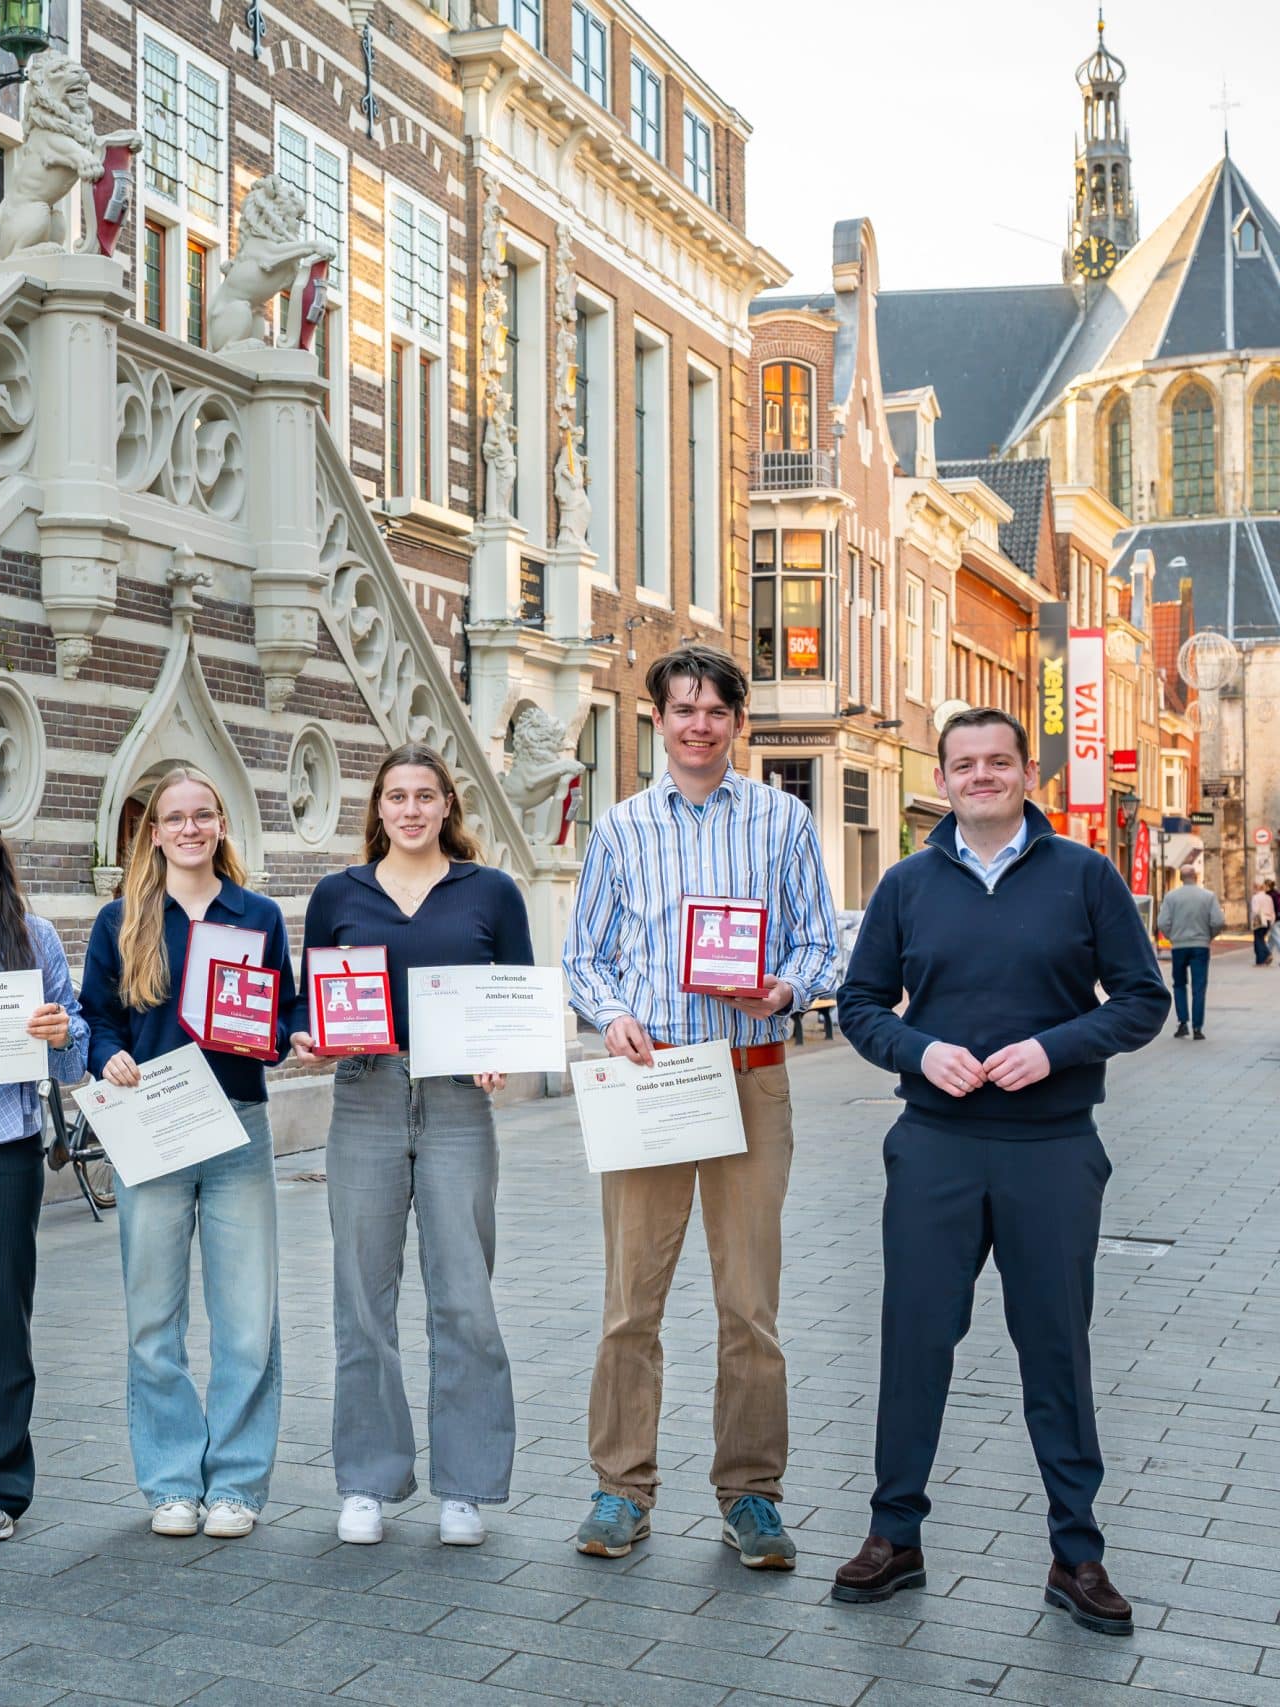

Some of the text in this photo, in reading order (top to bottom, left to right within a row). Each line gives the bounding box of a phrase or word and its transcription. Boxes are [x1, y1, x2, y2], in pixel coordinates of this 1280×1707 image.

[790, 637, 816, 653] 50%
[1044, 656, 1064, 735] xenos
[1075, 682, 1098, 760] SILYA
[754, 735, 831, 744] SENSE FOR LIVING
[491, 974, 527, 982] Oorkonde
[657, 1056, 694, 1068] Oorkonde
[142, 1064, 173, 1081] Oorkonde
[146, 1090, 161, 1101] Amy
[161, 1079, 189, 1096] Tijmstra
[636, 1082, 659, 1092] Guido
[660, 1080, 675, 1088] van
[675, 1071, 722, 1086] Hesselingen
